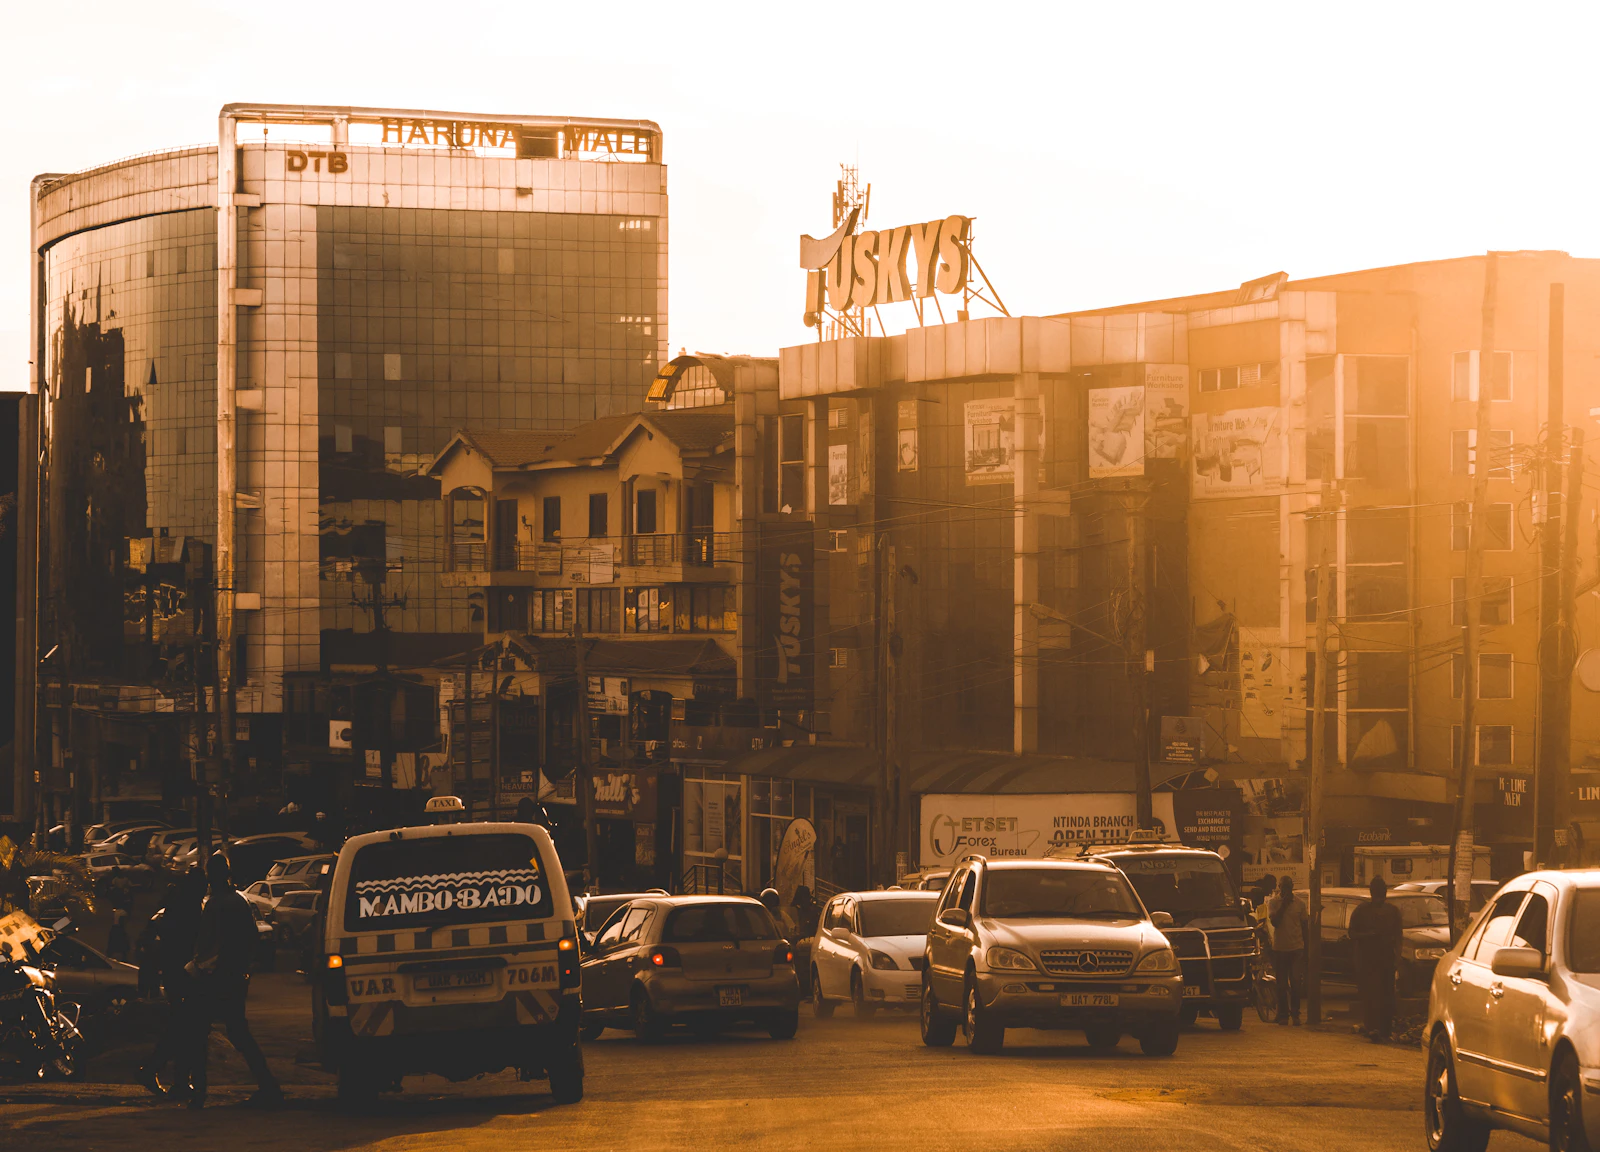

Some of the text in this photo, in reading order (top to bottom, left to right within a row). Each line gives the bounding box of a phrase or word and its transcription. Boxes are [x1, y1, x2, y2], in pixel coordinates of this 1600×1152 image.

[382, 117, 517, 149] HARUNA
[287, 151, 348, 173] DTB
[799, 207, 971, 313] TUSKYS
[773, 551, 802, 684] TUSKYS
[1510, 778, 1527, 793] LINE
[431, 800, 456, 808] TAXI
[1053, 815, 1134, 828] NTINDA BRANCH
[1197, 817, 1225, 825] EXCHANGE
[1209, 825, 1231, 833] RECEIVE
[1358, 828, 1392, 842] Ecobank
[956, 836, 997, 847] Forex
[990, 847, 1027, 856] Bureau
[358, 884, 542, 919] MAMBO-BADO
[507, 965, 557, 986] 706M
[350, 977, 397, 997] UAR
[1071, 994, 1089, 1005] UAT
